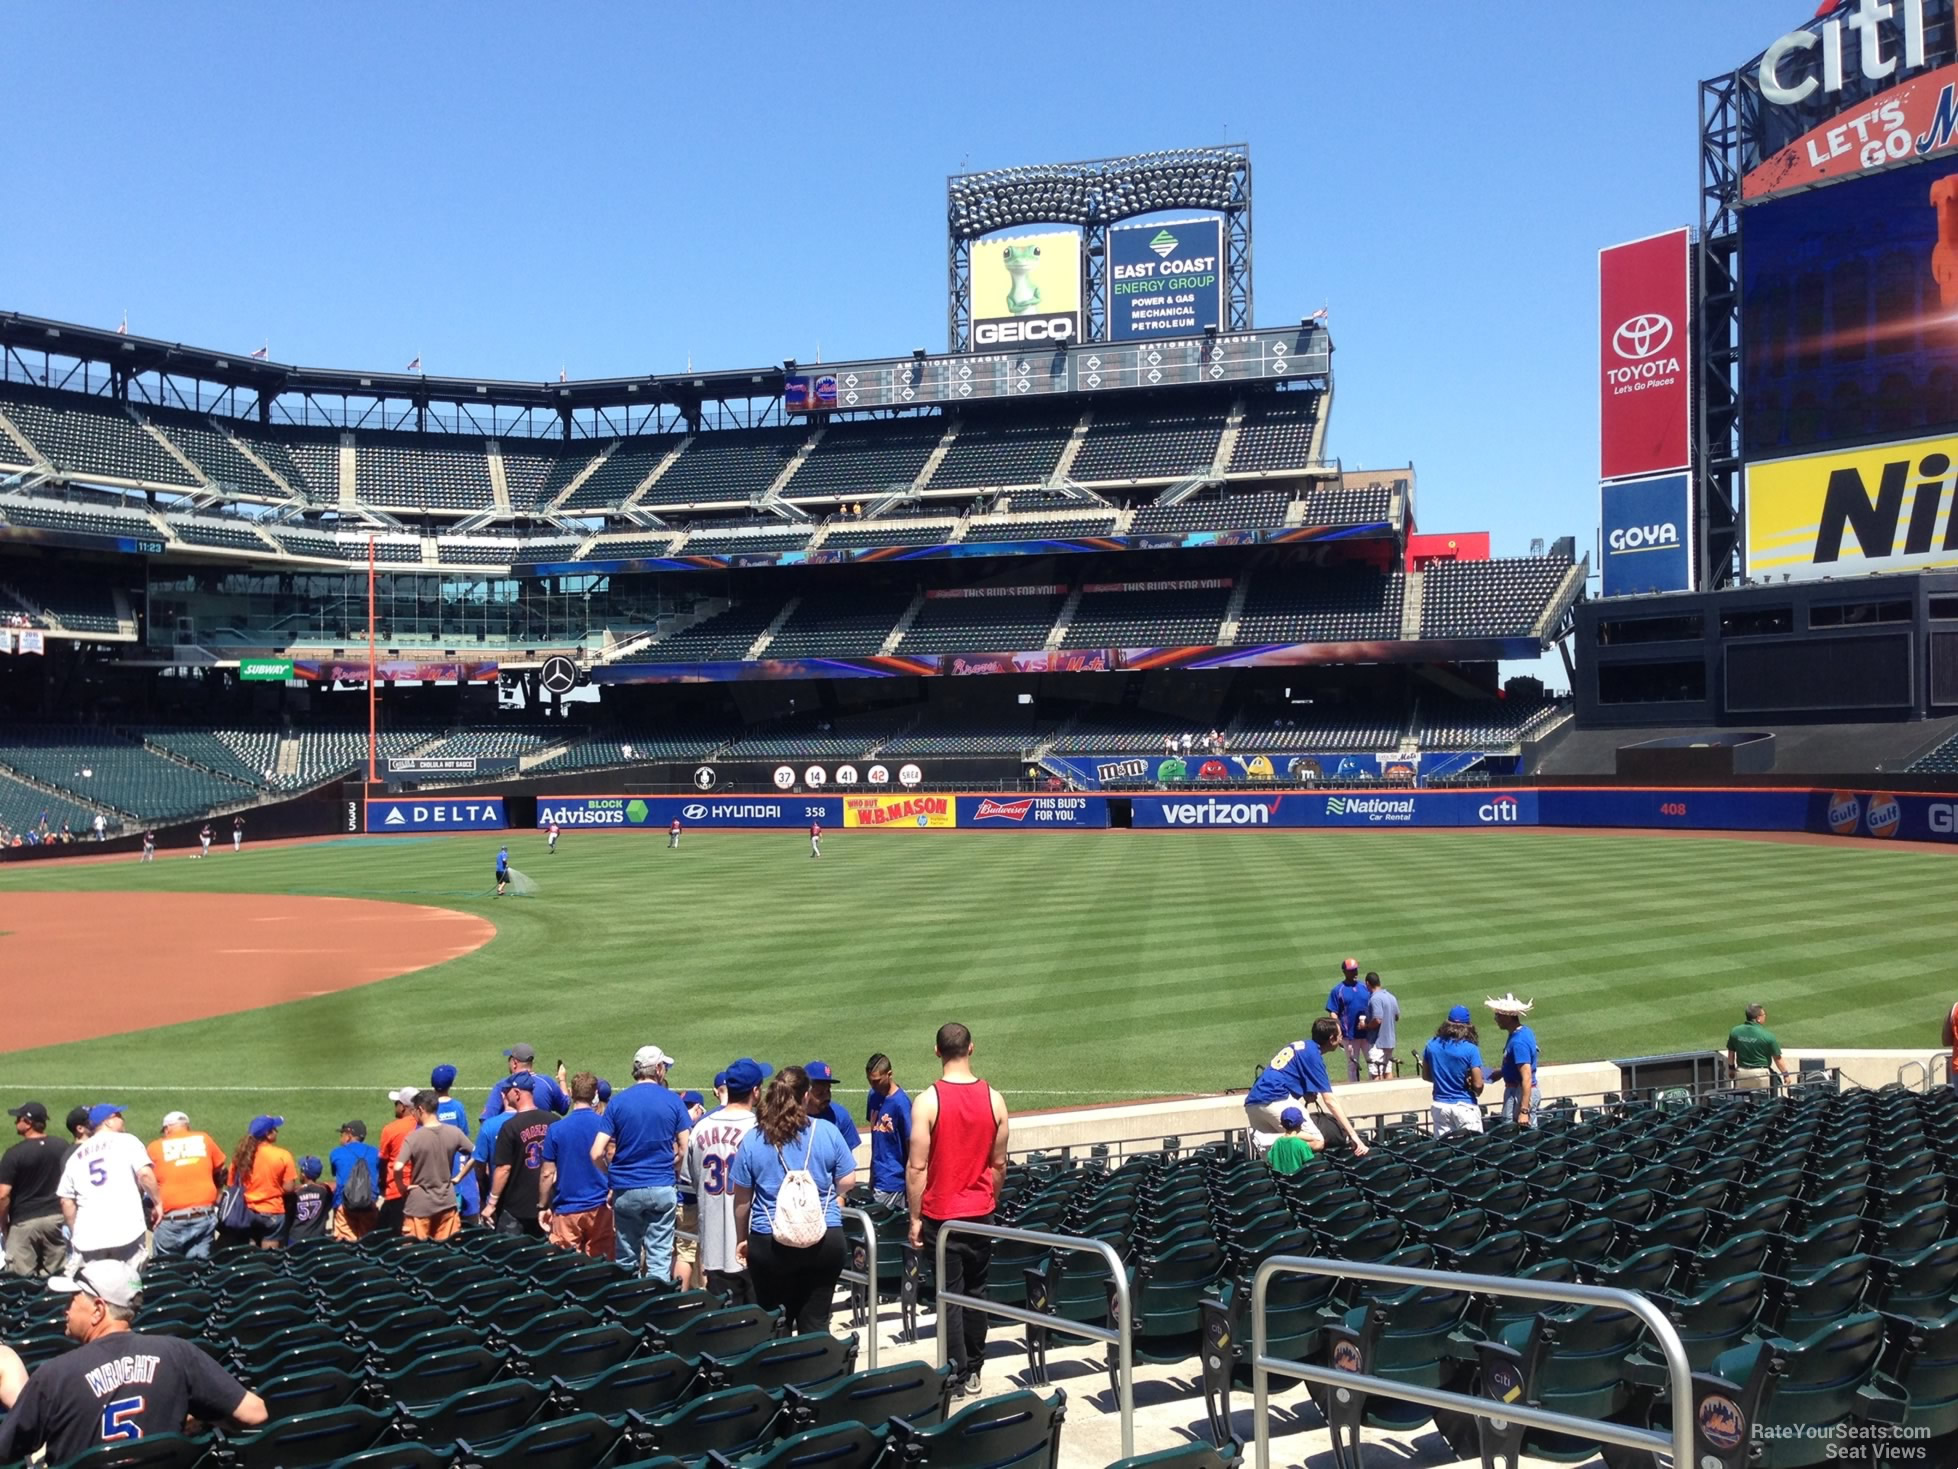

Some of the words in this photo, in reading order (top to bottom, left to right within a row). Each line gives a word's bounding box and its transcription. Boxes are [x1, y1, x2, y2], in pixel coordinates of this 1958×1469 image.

[1759, 0, 1924, 104] citi
[1806, 100, 1905, 167] LET'S
[1860, 129, 1912, 168] GO
[1114, 263, 1155, 279] EAST
[1160, 257, 1215, 275] COAST
[1114, 280, 1164, 295] ENERGY
[1168, 276, 1215, 290] GROUP
[1132, 297, 1164, 307] POWER
[1167, 296, 1173, 304] &
[1176, 294, 1195, 303] GAS
[1132, 307, 1195, 319] MECHANICAL
[975, 318, 1072, 344] GEICO
[1132, 319, 1195, 331] PETROLEUM
[1139, 340, 1200, 350] NATIONAL
[1208, 336, 1257, 345] LEAGUE
[963, 355, 1008, 364] LEAGUE
[1607, 358, 1680, 384] TOYOTA
[1614, 385, 1633, 395] Let's
[1634, 382, 1646, 391] Go
[1647, 378, 1674, 388] Places
[1812, 453, 1958, 563] Ni
[1610, 523, 1676, 549] GOYA
[138, 542, 161, 552] 11:23
[964, 588, 985, 598] THIS
[1017, 586, 1036, 596] FOR
[1122, 583, 1145, 592] THIS
[1179, 580, 1199, 590] FOR
[244, 664, 289, 675] SUBWAY
[778, 772, 790, 782] 37
[811, 772, 820, 782] 14
[842, 771, 852, 782] 41
[872, 771, 884, 781] 42
[902, 771, 918, 780] SHEA
[588, 800, 622, 809] BLOCK
[848, 800, 862, 808] WHO
[864, 799, 878, 807] BUT
[981, 804, 1027, 815] Budweiser
[1035, 799, 1055, 808] THIS
[1058, 798, 1086, 808] BUD'S
[1162, 798, 1268, 823] verizon
[1346, 798, 1412, 813] National
[1478, 800, 1516, 821] citi
[1660, 804, 1686, 816] 408
[414, 806, 497, 822] DELTA
[540, 806, 623, 824] Advisors
[712, 805, 781, 818] HYUNDAI
[805, 807, 826, 818] 358
[1035, 810, 1052, 820] FOR
[1830, 803, 1857, 823] Gulf
[1869, 806, 1897, 826] Gulf
[1928, 804, 1958, 832] G
[1271, 1046, 1294, 1070] 8
[520, 1124, 548, 1142] PIAZZ
[696, 1126, 743, 1151] PIAZZ
[89, 1158, 107, 1186] 5
[297, 1200, 322, 1220] 57
[86, 1354, 160, 1397] WRIGHT
[1494, 1373, 1510, 1387] citi
[102, 1396, 144, 1440] 5
